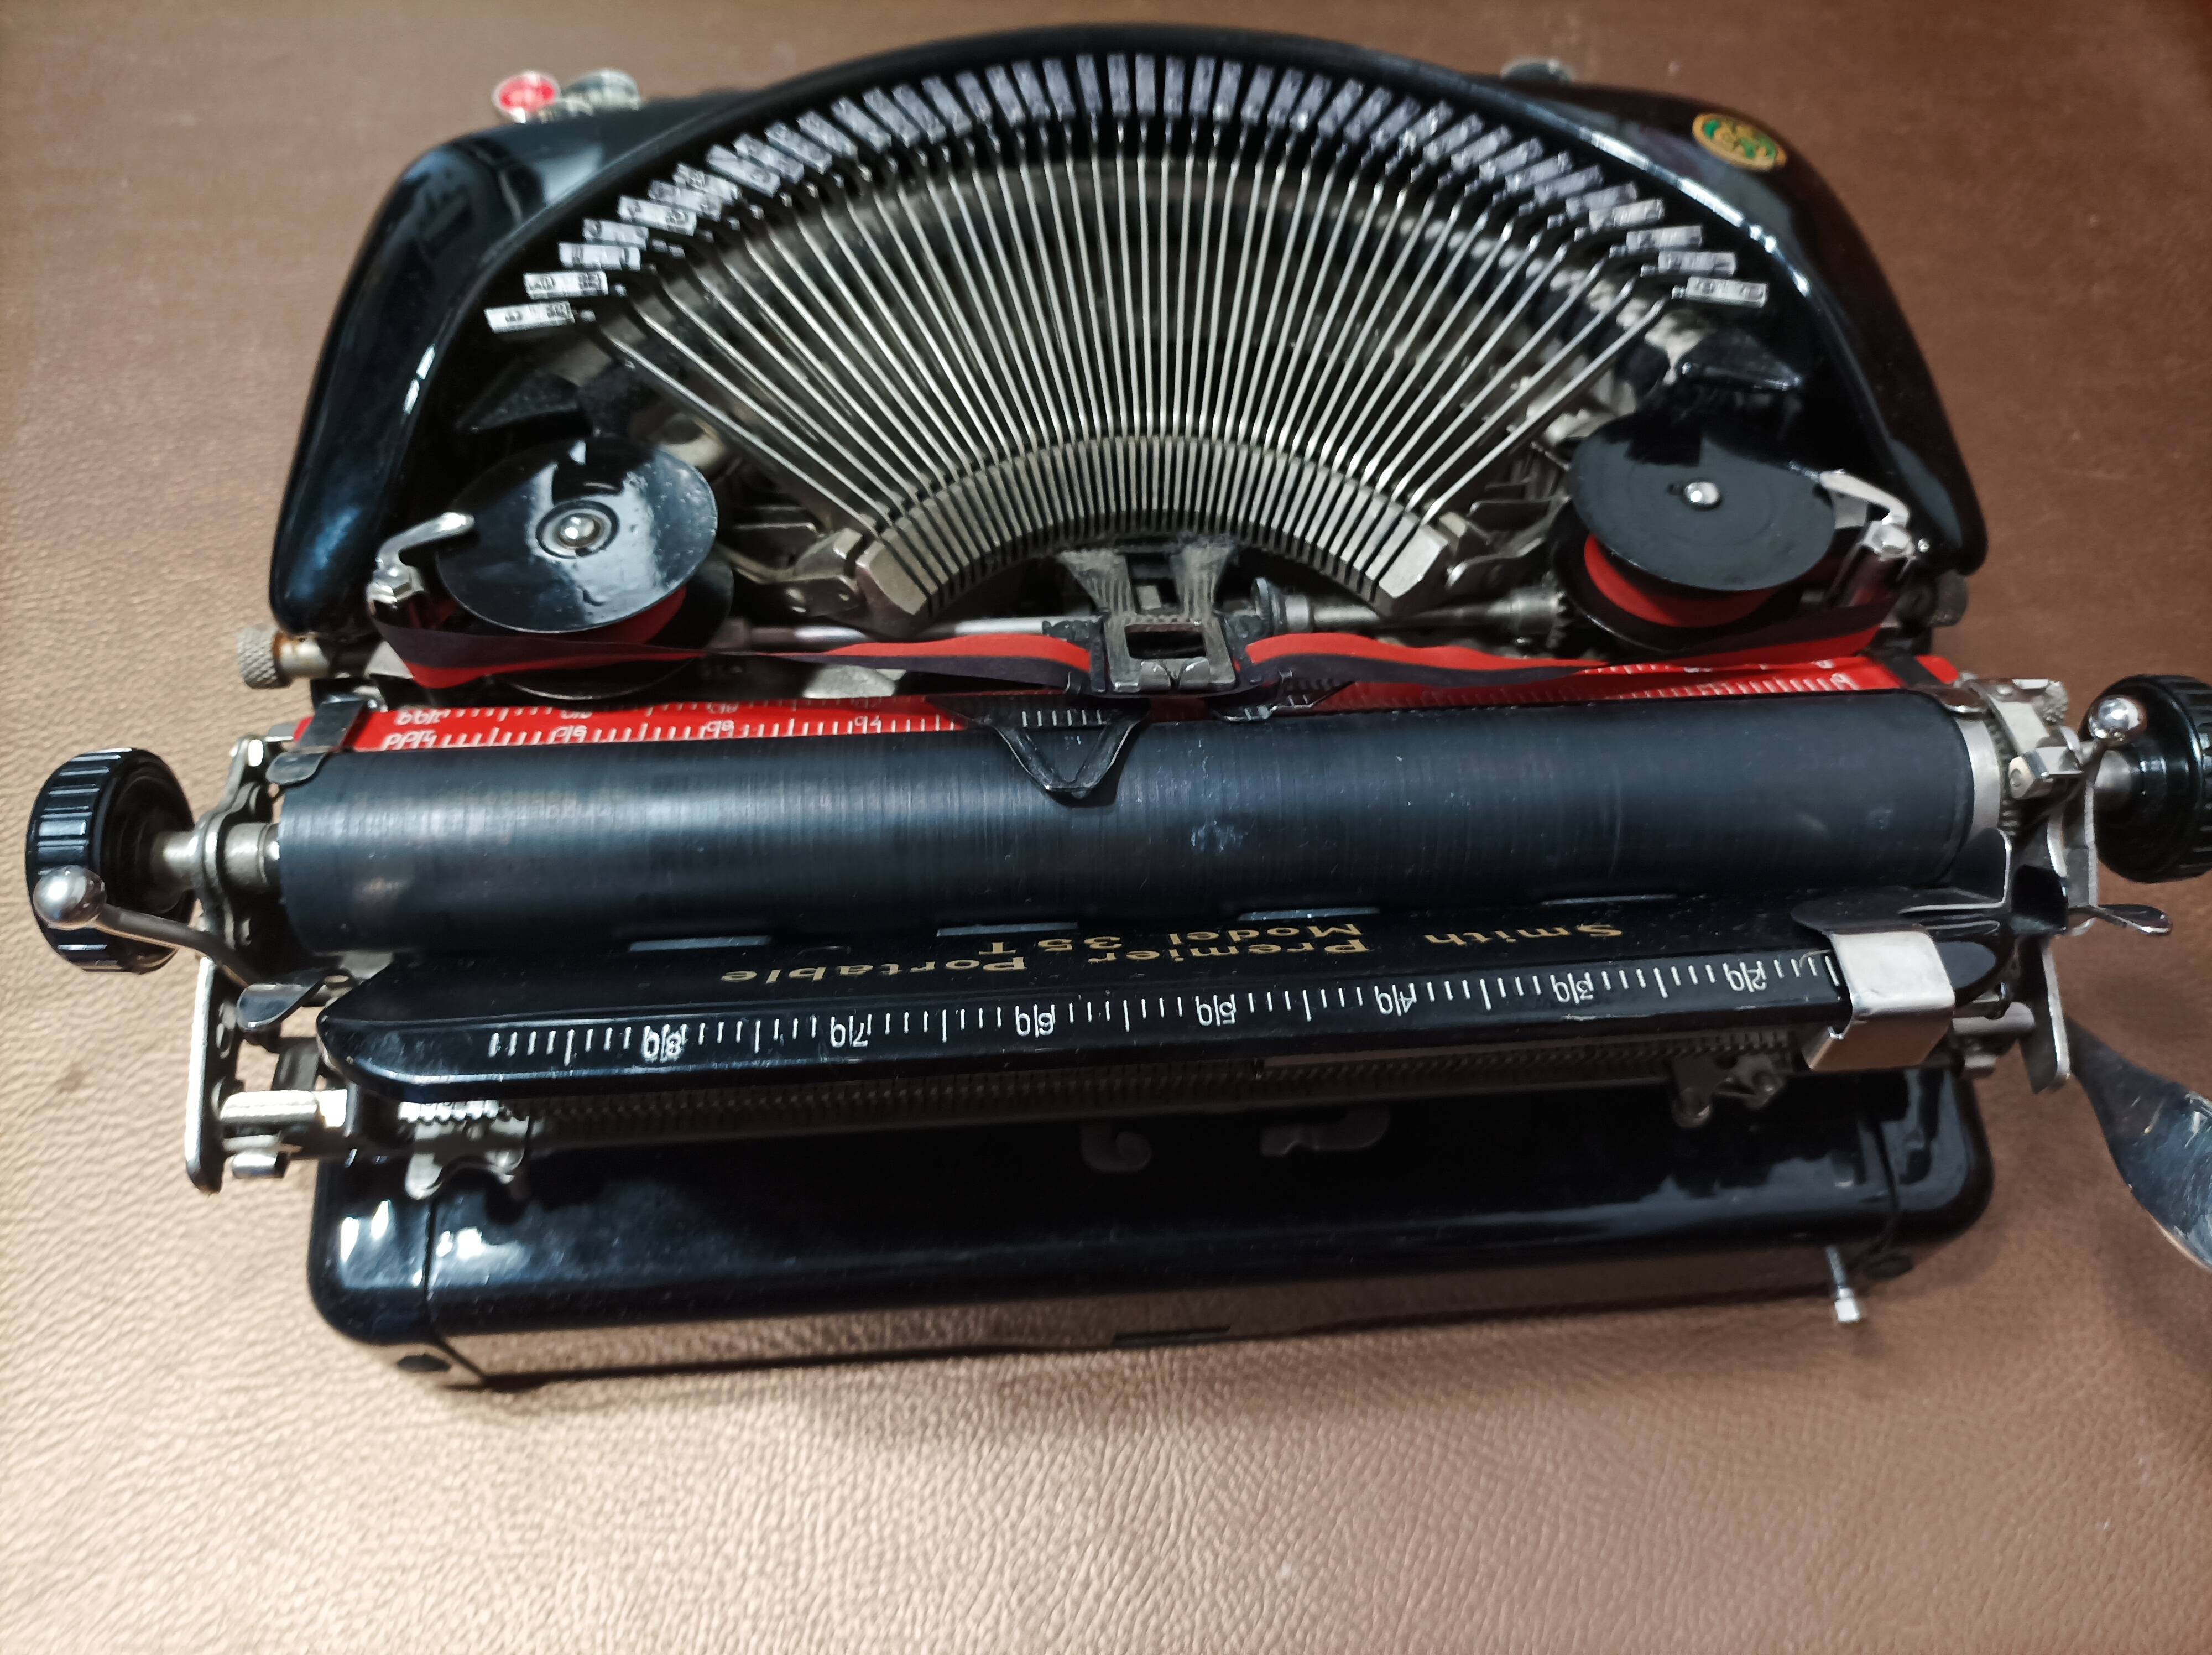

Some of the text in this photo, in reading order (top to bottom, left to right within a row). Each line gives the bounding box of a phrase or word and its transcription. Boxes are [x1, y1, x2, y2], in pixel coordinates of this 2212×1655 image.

[720, 923, 1623, 984] Smith Premier Portable
[978, 923, 1363, 955] Model 35 T
[640, 969, 1767, 1060] 20 30 40 50 60 70 80
